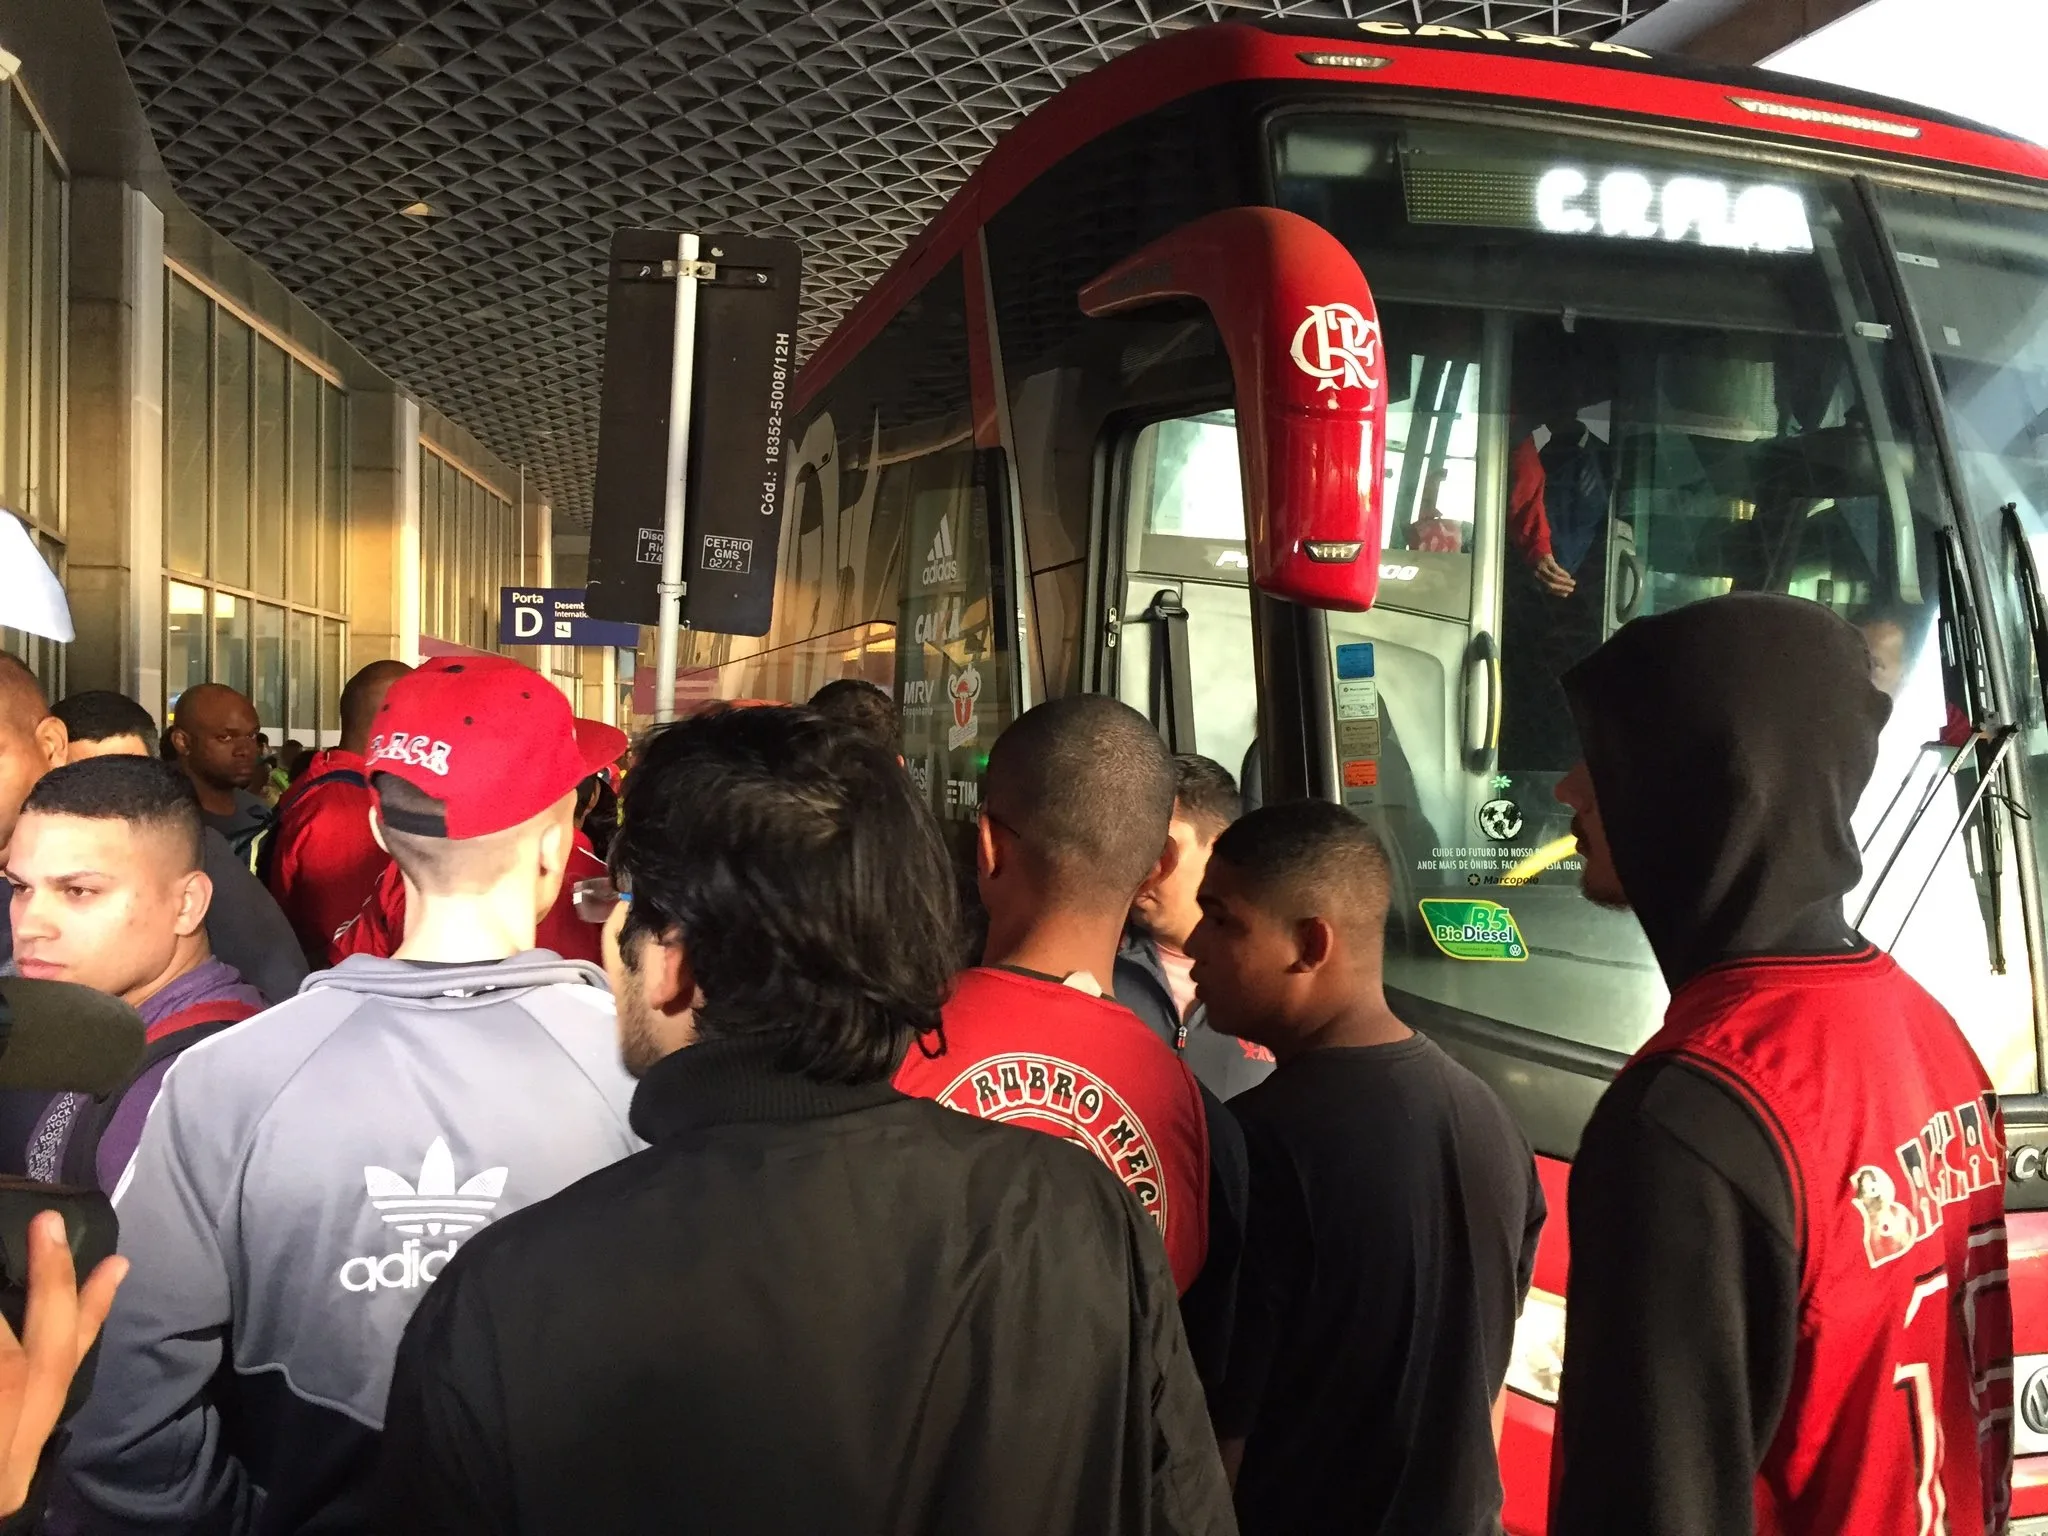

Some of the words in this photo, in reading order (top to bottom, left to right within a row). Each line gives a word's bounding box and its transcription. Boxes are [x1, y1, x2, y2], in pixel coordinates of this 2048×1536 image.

[1357, 21, 1653, 59] CAIXA
[765, 332, 790, 465] 18352-5008/12H
[705, 537, 752, 552] CET-RIO
[714, 548, 740, 560] GMS
[922, 560, 957, 585] adidas
[512, 592, 544, 604] Porta
[515, 606, 544, 637] D
[903, 679, 935, 705] MRV
[958, 780, 978, 806] TIM
[1432, 847, 1454, 858] CUIDE
[1456, 847, 1467, 857] DO
[1468, 847, 1496, 858] FUTURO
[1498, 847, 1509, 858] DO
[1510, 847, 1534, 858] NOSSO
[1417, 861, 1437, 870] ANDE
[1458, 861, 1468, 870] DE
[1563, 861, 1582, 871] IDEIA
[1483, 875, 1539, 886] Marcopolo
[1471, 907, 1510, 933] B5
[1437, 924, 1514, 942] BioDiesel
[972, 1062, 1104, 1124] RUBRO
